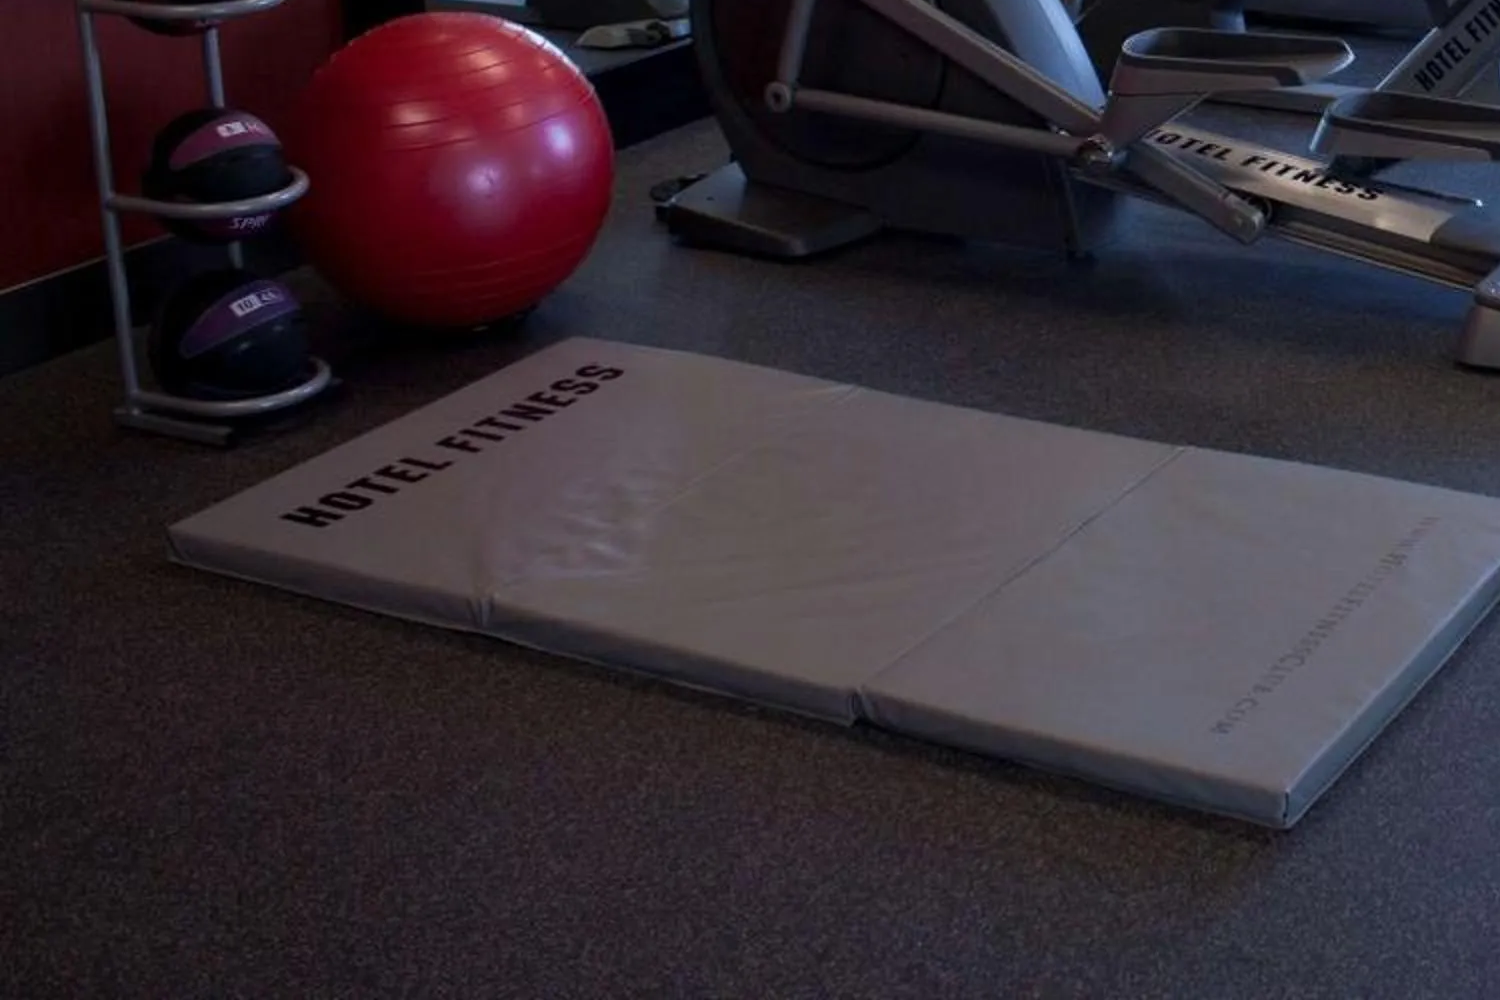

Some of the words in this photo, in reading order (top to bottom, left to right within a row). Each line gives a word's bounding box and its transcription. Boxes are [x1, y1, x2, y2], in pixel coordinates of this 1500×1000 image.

[1413, 36, 1471, 92] HOTEL
[1241, 155, 1384, 201] FITNESS
[279, 457, 454, 528] HOTEL
[434, 361, 625, 454] FITNESS
